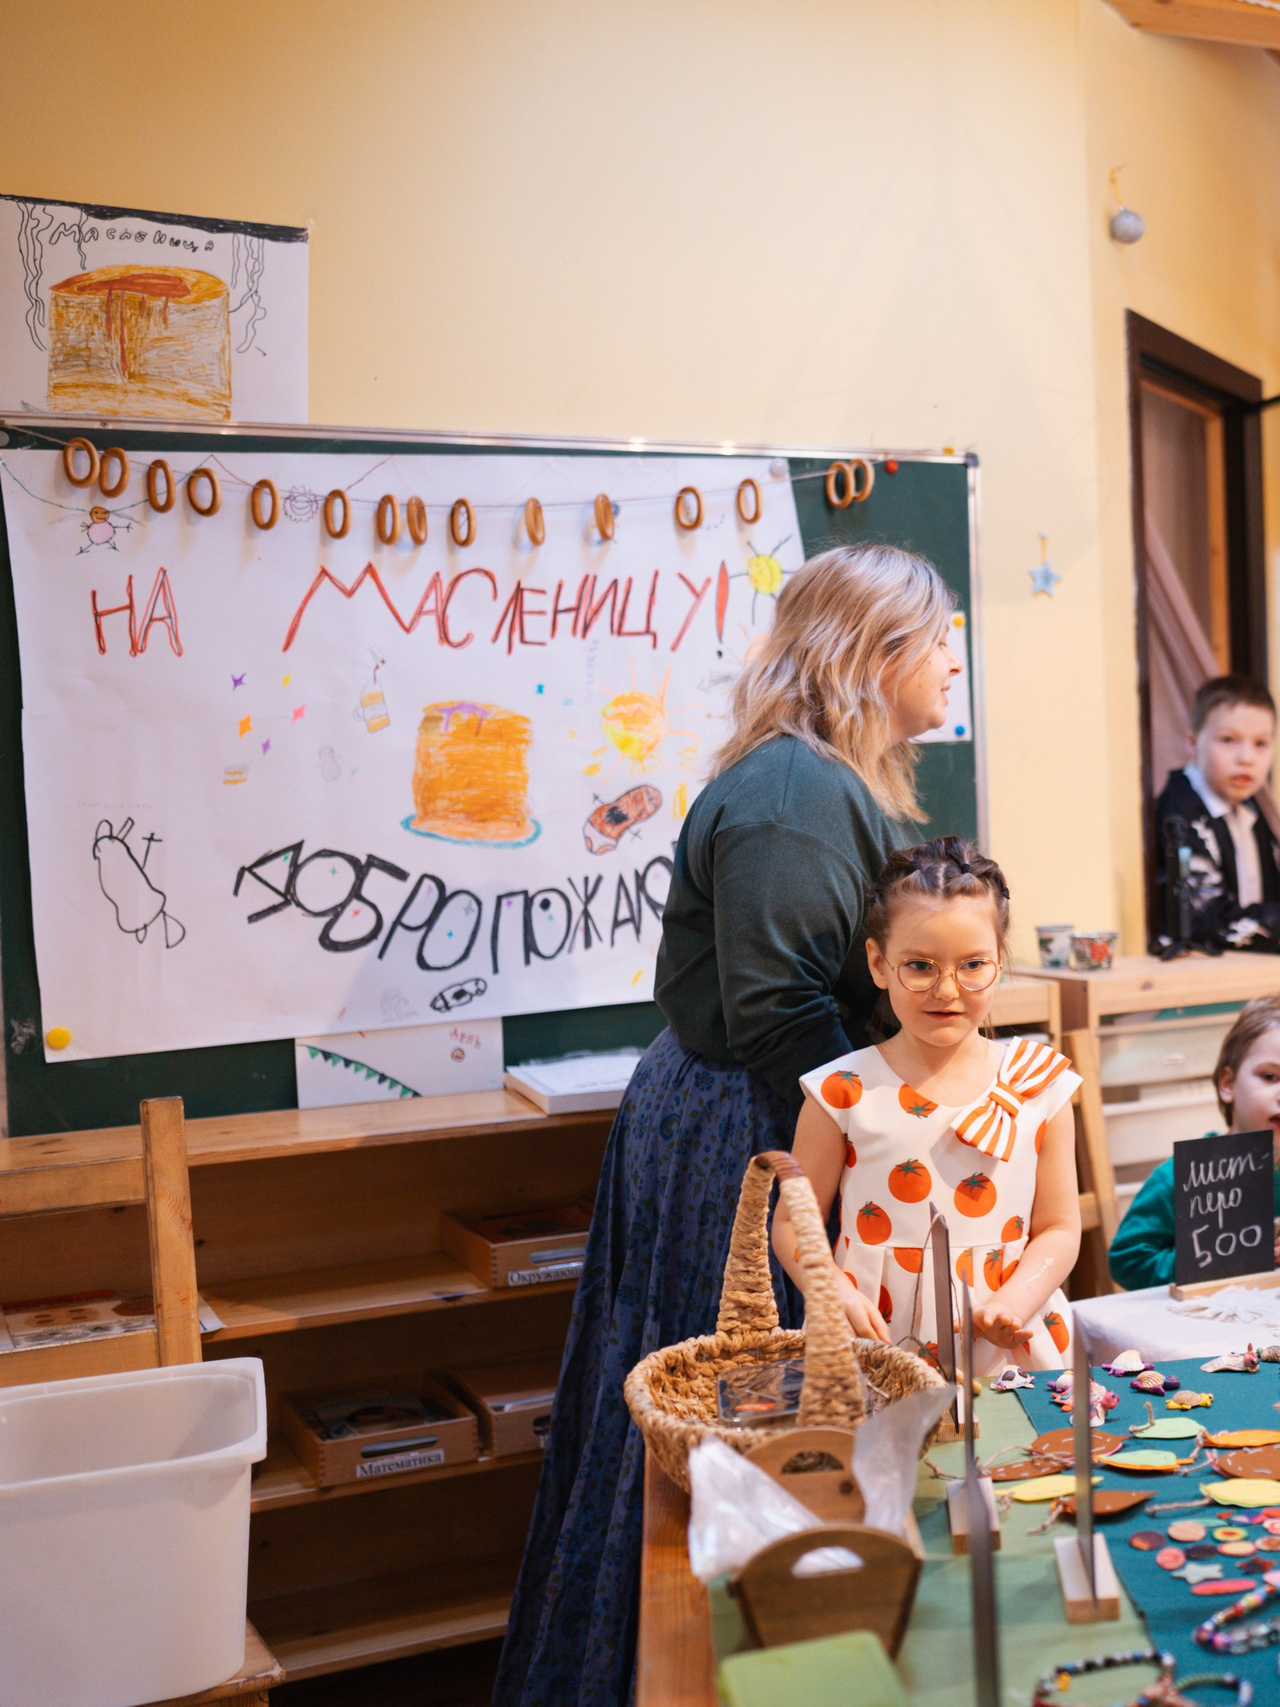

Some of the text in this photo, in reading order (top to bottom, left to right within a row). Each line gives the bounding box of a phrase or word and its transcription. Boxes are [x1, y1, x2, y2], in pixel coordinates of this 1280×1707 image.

[91, 560, 730, 659] НА МАСЛЕНИЦУ!
[1192, 1224, 1263, 1268] 500
[359, 1453, 442, 1477] Математика
